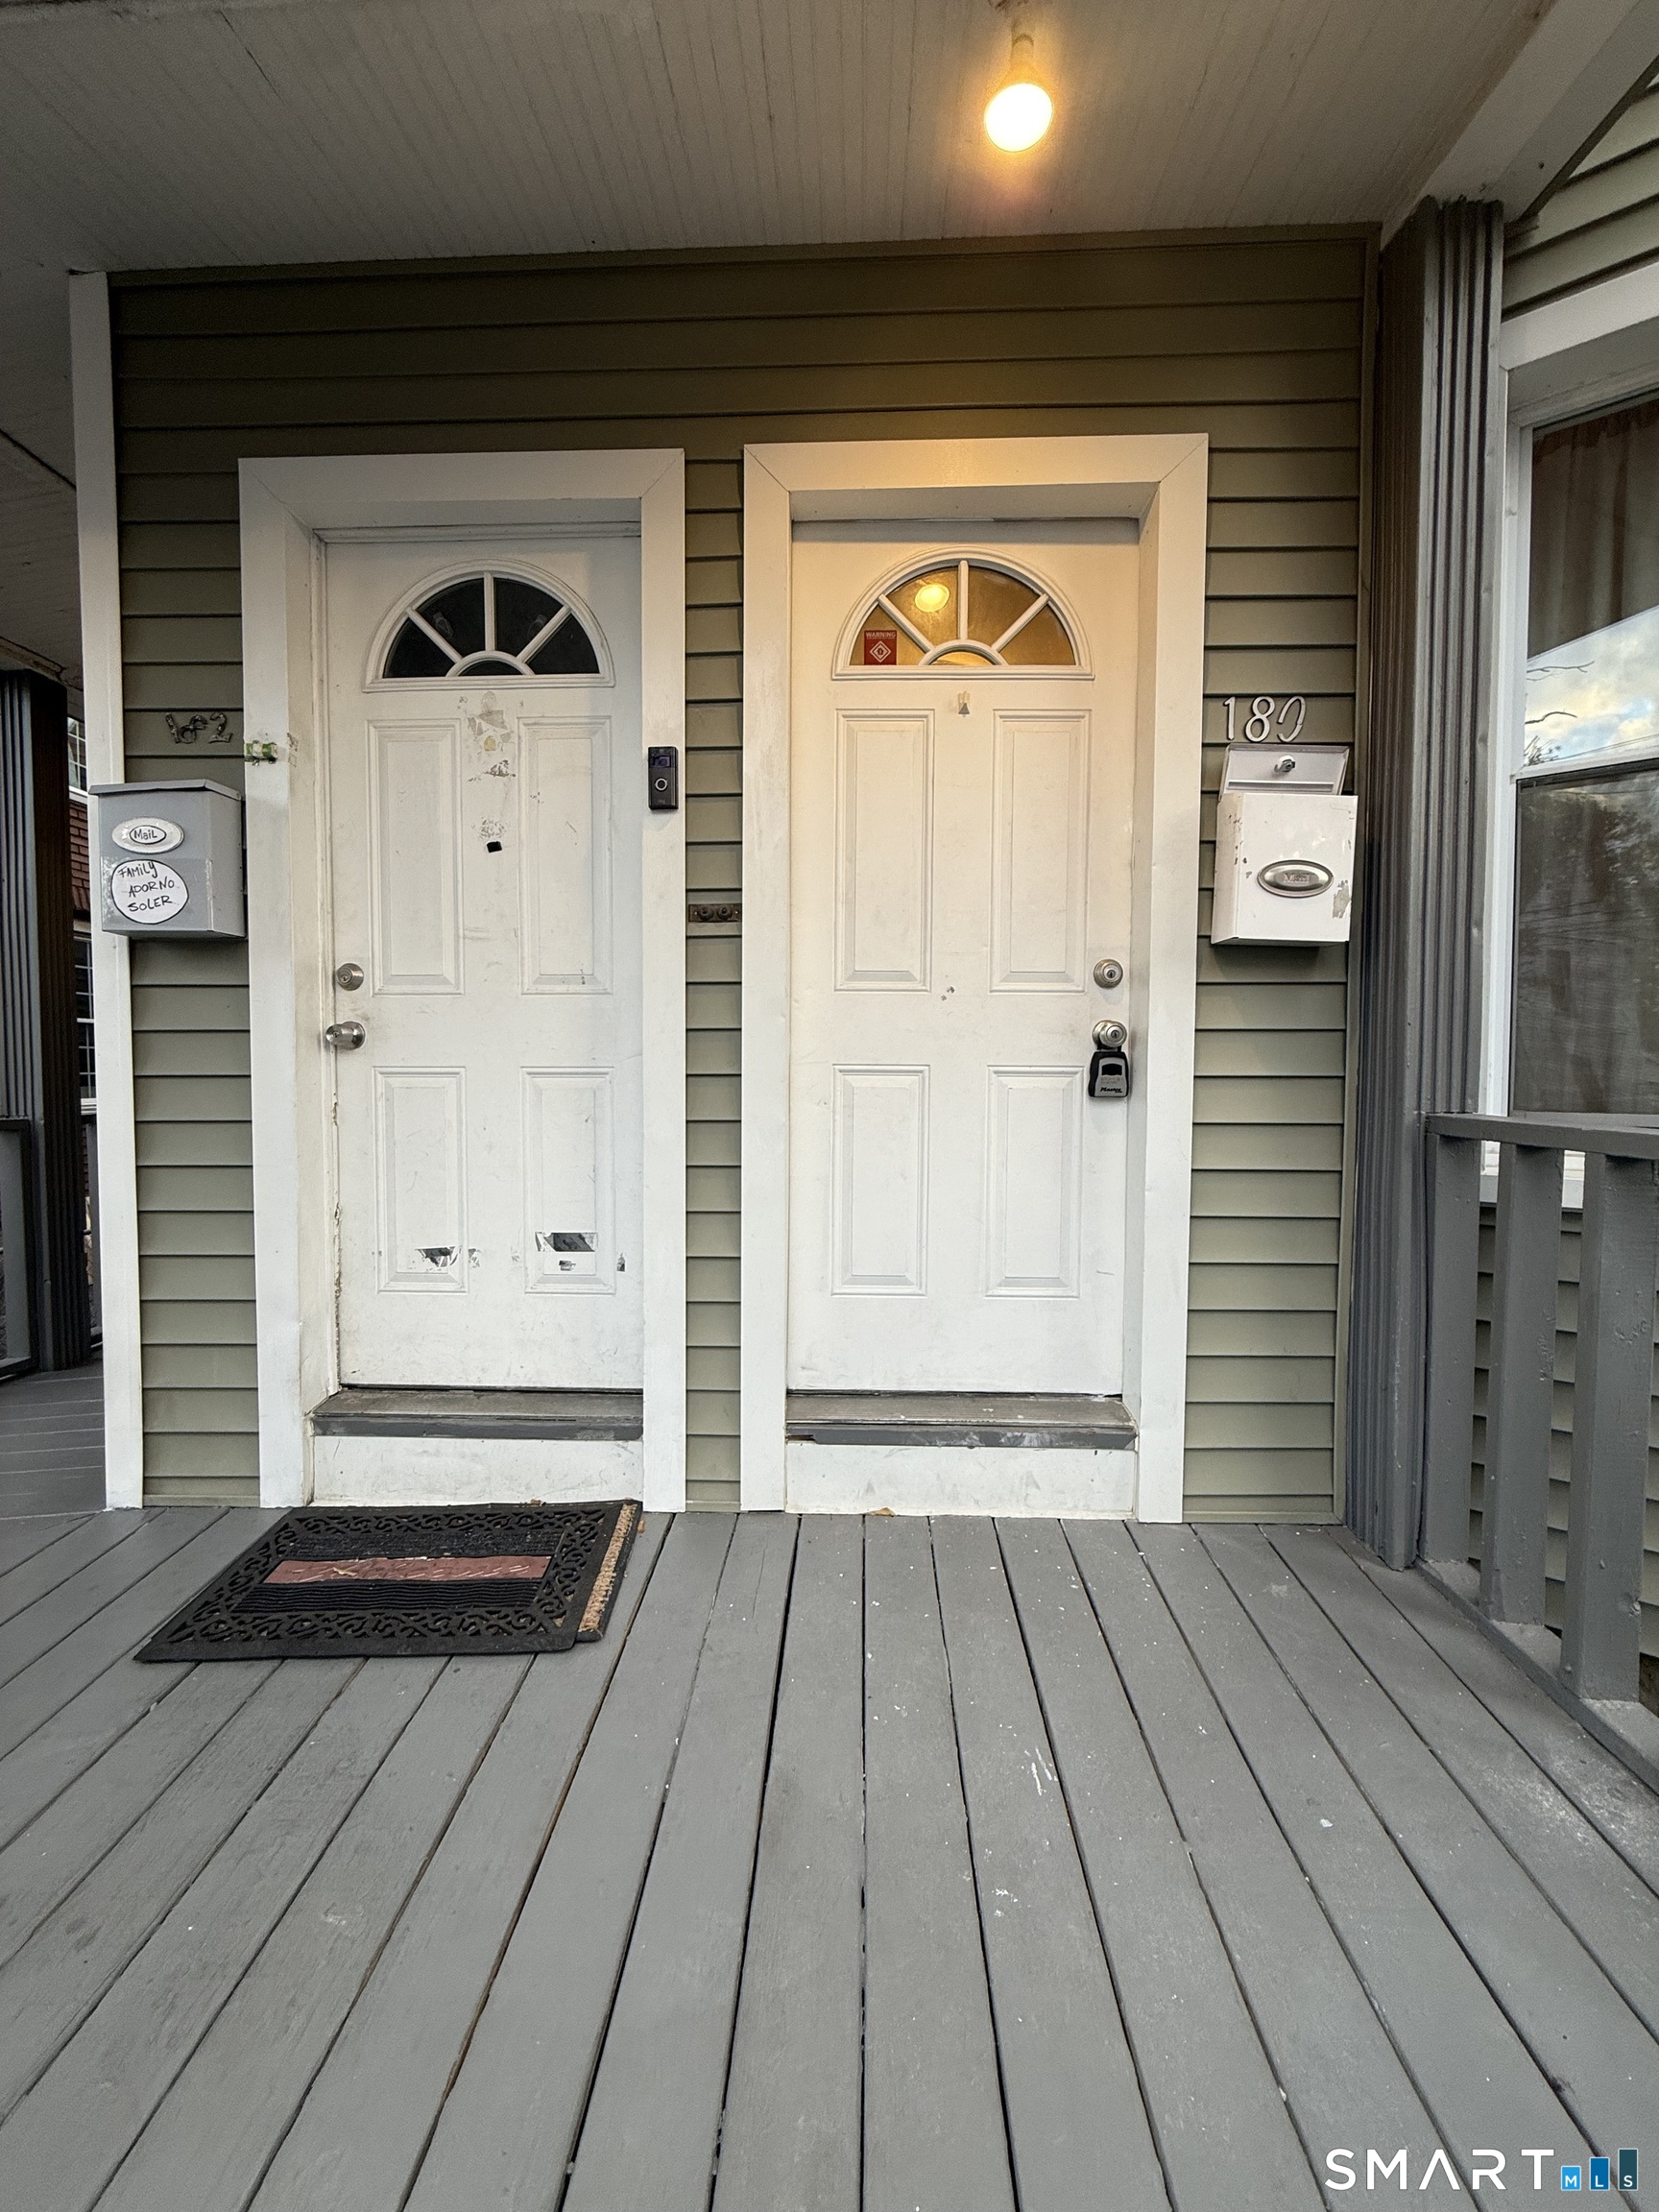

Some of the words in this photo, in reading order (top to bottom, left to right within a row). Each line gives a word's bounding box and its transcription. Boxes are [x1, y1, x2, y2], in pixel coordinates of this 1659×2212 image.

[1223, 695, 1307, 743] 180
[128, 876, 175, 898] ADORNO
[1283, 873, 1311, 884] Mail
